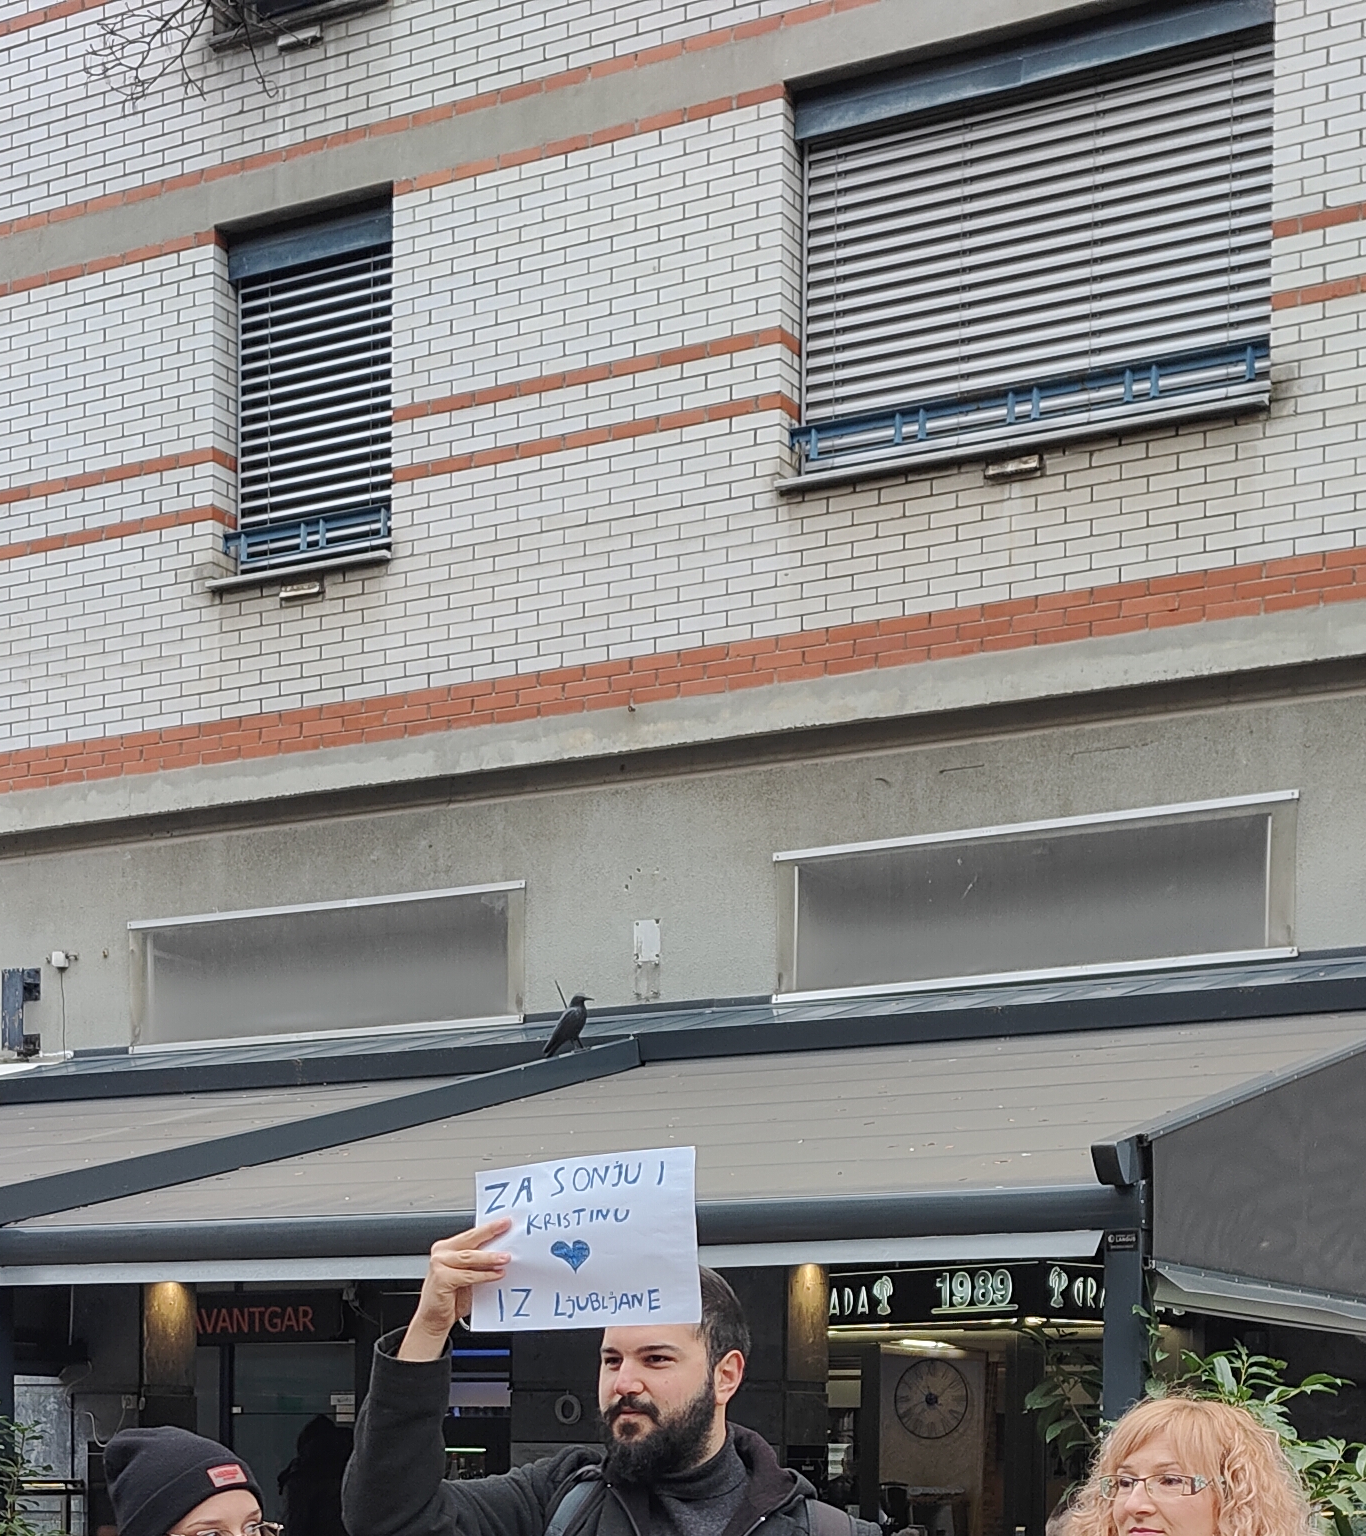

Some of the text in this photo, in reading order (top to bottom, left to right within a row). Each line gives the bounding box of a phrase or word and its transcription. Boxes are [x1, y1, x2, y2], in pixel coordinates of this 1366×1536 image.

[484, 1176, 533, 1215] ZA
[657, 1160, 665, 1186] I
[526, 1207, 630, 1236] KRISTINU
[498, 1288, 533, 1323] IZ
[936, 1268, 1013, 1308] 1989
